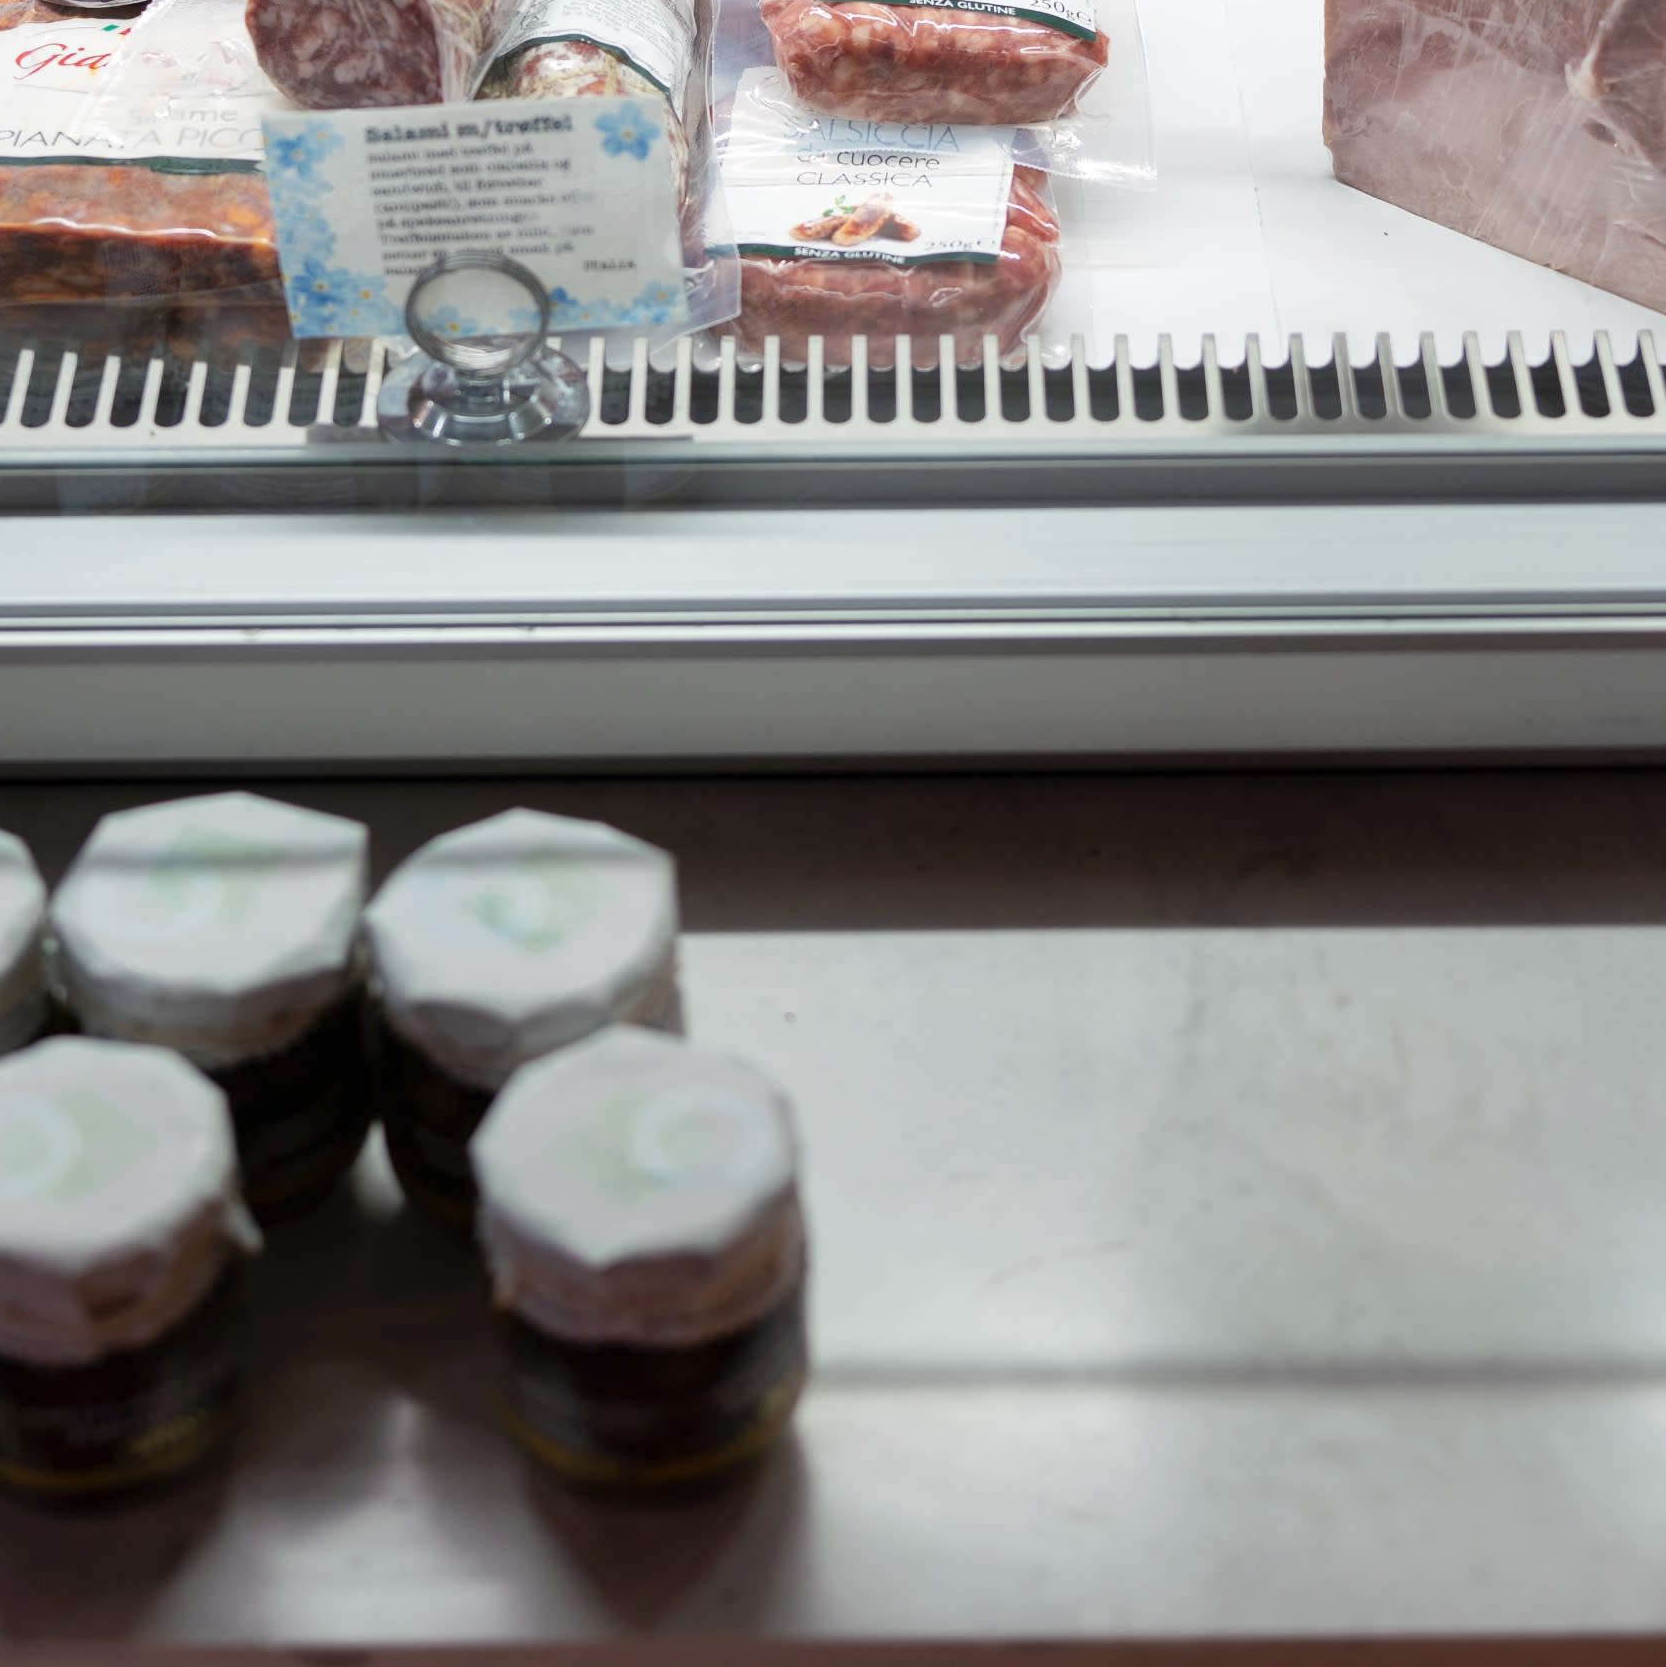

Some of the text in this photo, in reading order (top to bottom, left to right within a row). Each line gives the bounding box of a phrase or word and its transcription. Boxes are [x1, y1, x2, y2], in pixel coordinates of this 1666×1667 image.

[957, 0, 1016, 16] GLUTINE
[365, 122, 450, 144] Salami
[836, 150, 940, 170] cuocere
[797, 171, 933, 187] CLASSICA
[794, 247, 906, 264] SENZA GLUTINE
